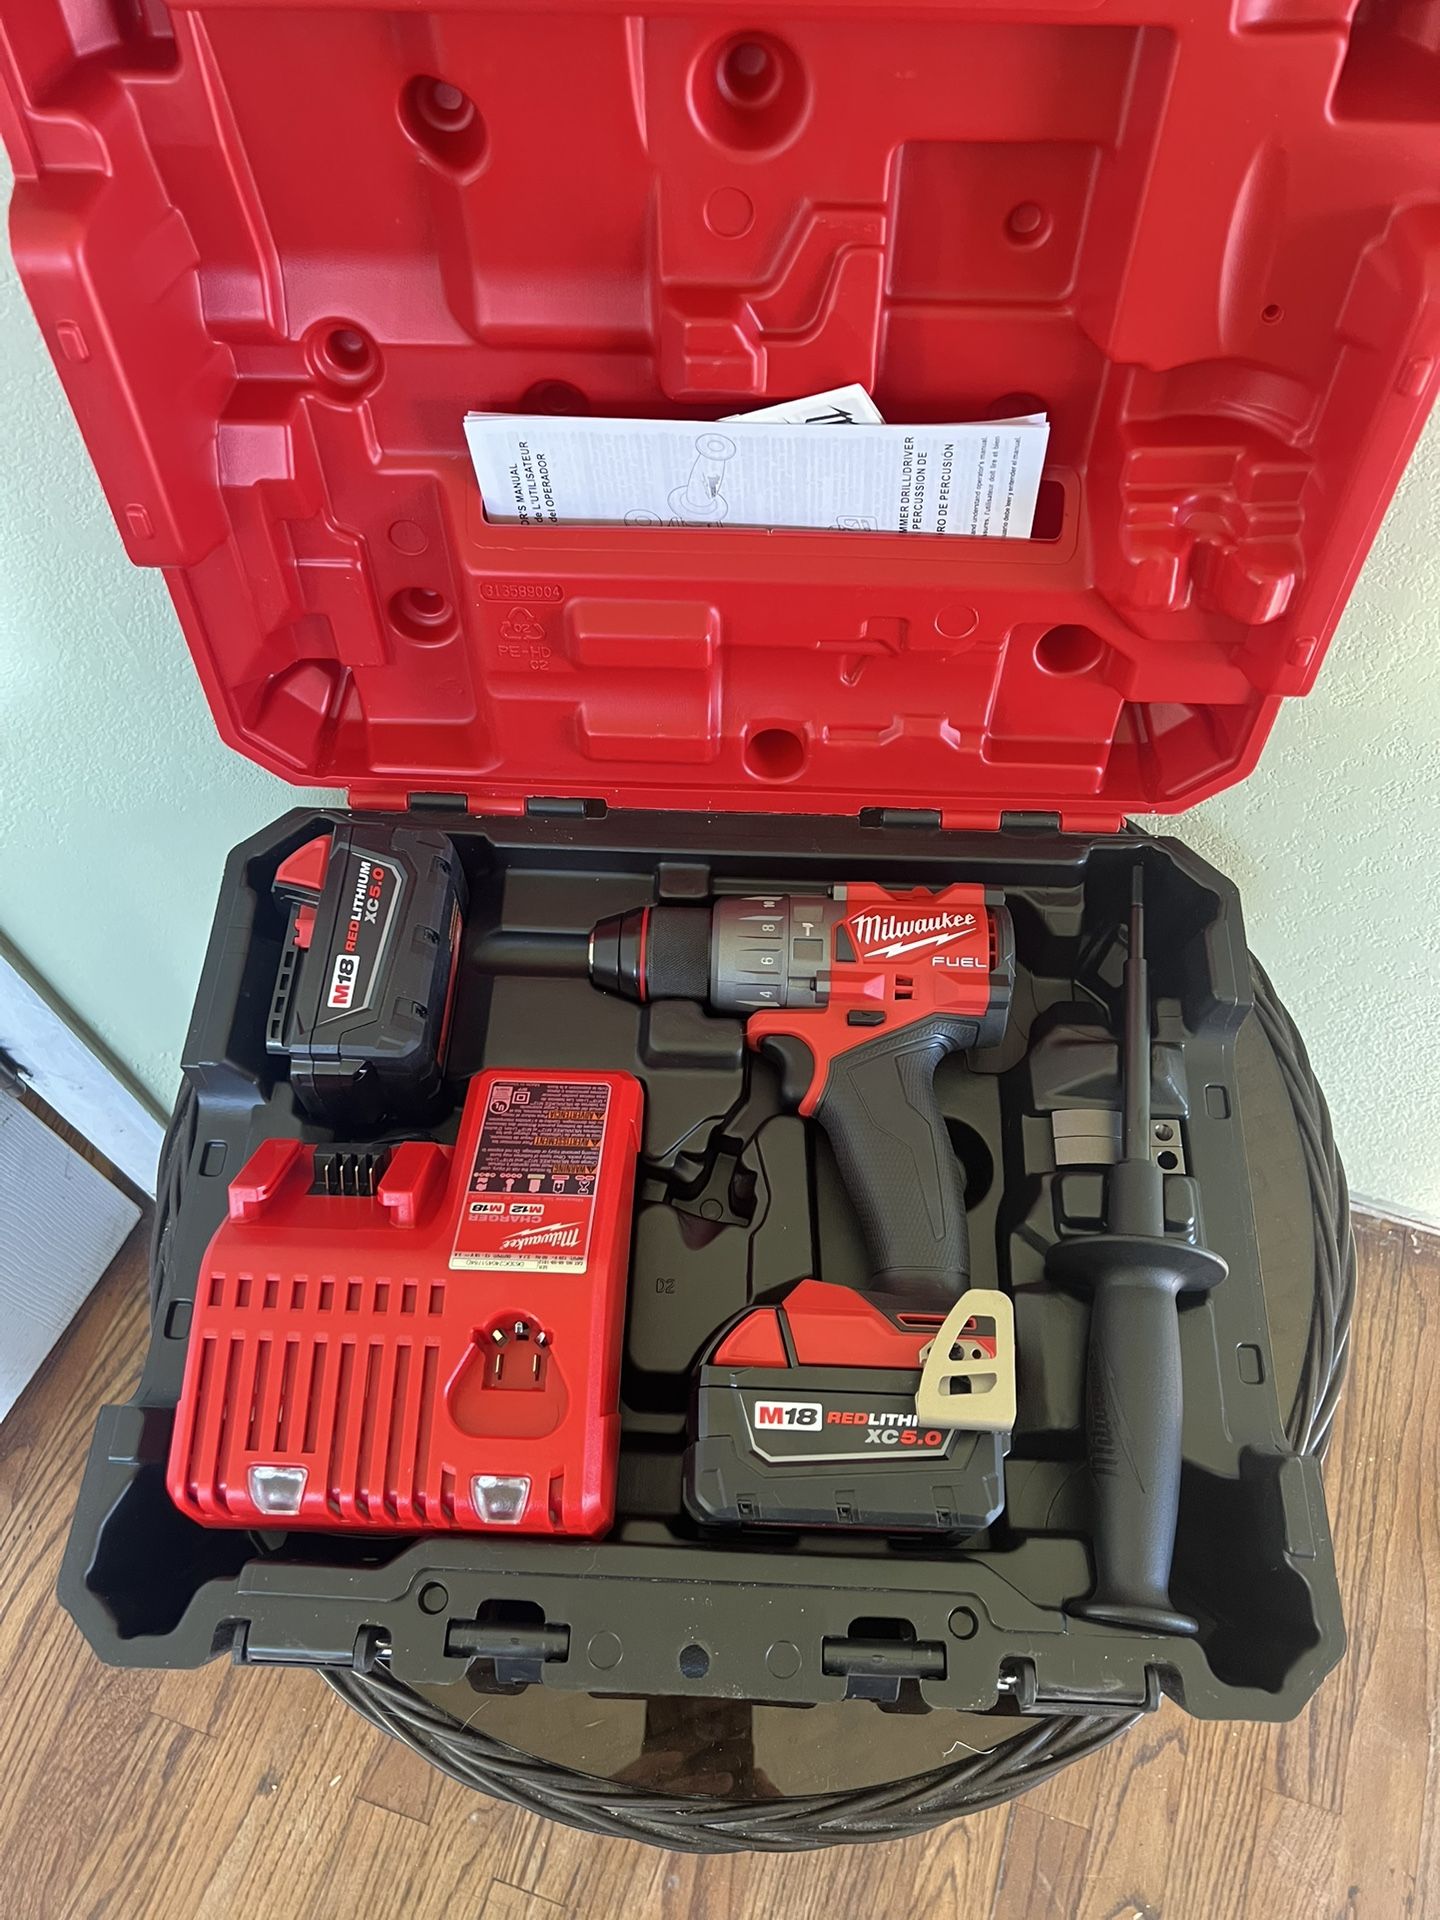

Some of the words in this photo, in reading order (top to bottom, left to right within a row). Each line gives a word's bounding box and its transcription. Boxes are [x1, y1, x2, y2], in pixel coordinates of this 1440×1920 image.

[918, 452, 927, 465] DE
[519, 442, 541, 509] L'UTILISATEUR
[901, 437, 914, 503] DRILL/DRIVER
[939, 444, 954, 500] PERCUSIÓN
[976, 461, 985, 490] operator's
[1008, 466, 1017, 491] entender
[509, 464, 524, 503] MANUAL
[537, 454, 554, 507] OPERADOR
[912, 468, 926, 529] PERCUSSION
[972, 491, 981, 523] understand
[534, 512, 543, 523] de
[547, 509, 557, 522] del
[938, 504, 948, 516] DE
[937, 519, 946, 536] RO
[485, 584, 560, 597] 313589004
[514, 624, 531, 633] 02
[498, 645, 551, 659] PE-HD
[364, 867, 385, 925] XC5.0
[332, 958, 354, 1004] M18
[344, 861, 371, 953] REDLITHIUM
[761, 924, 776, 932] 8
[851, 912, 977, 944] Milwaukee
[760, 957, 774, 965] 6
[932, 956, 988, 968] FUEL
[553, 1164, 586, 1174] WARNING
[471, 1204, 502, 1212] M18
[511, 1205, 542, 1213] M12
[468, 1214, 542, 1223] CHARGER
[502, 1228, 581, 1250] Milwaukee
[656, 1278, 676, 1294] D2
[759, 1406, 818, 1425] M18
[827, 1411, 919, 1426] REDLITHI
[865, 1429, 942, 1446] XC5.0
